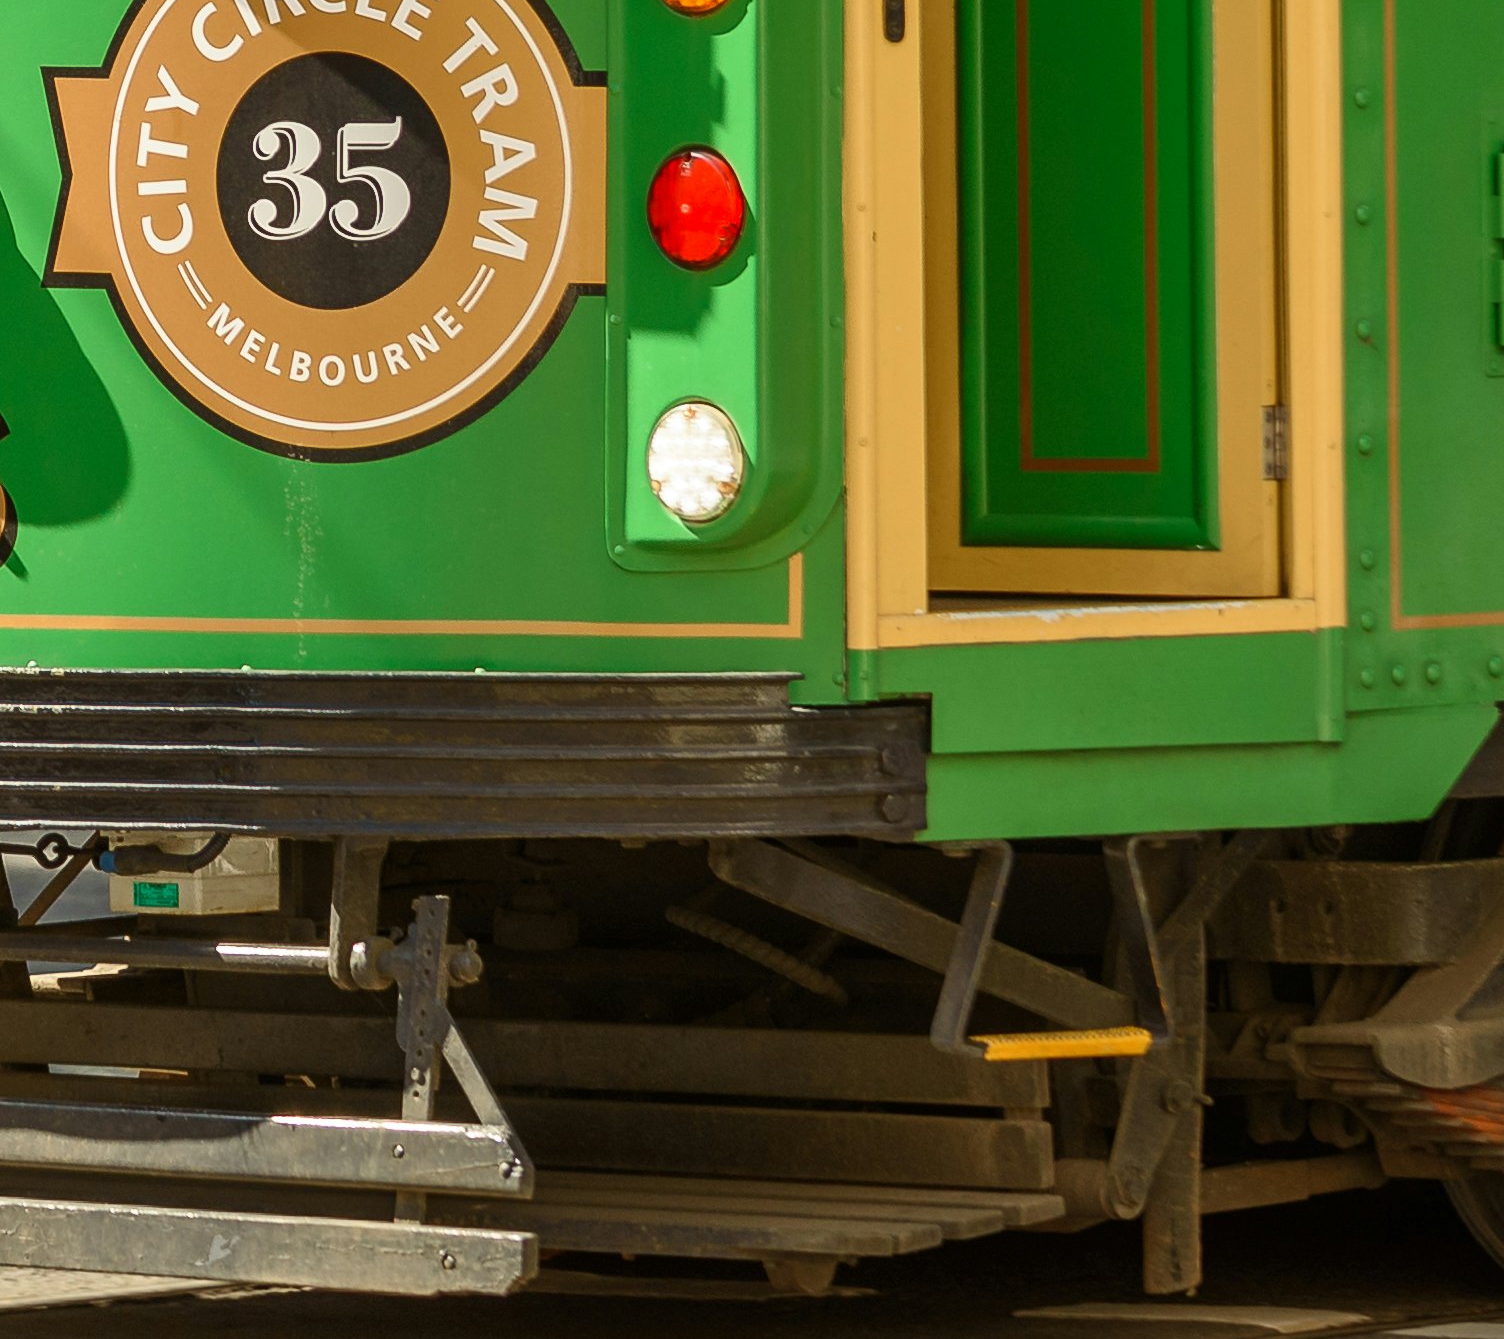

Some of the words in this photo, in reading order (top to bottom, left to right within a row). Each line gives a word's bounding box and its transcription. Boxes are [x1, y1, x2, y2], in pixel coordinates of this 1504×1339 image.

[137, 65, 200, 255] CITY
[442, 17, 539, 261] TRAM
[247, 115, 411, 241] 35
[206, 301, 464, 387] MELBOURNE
